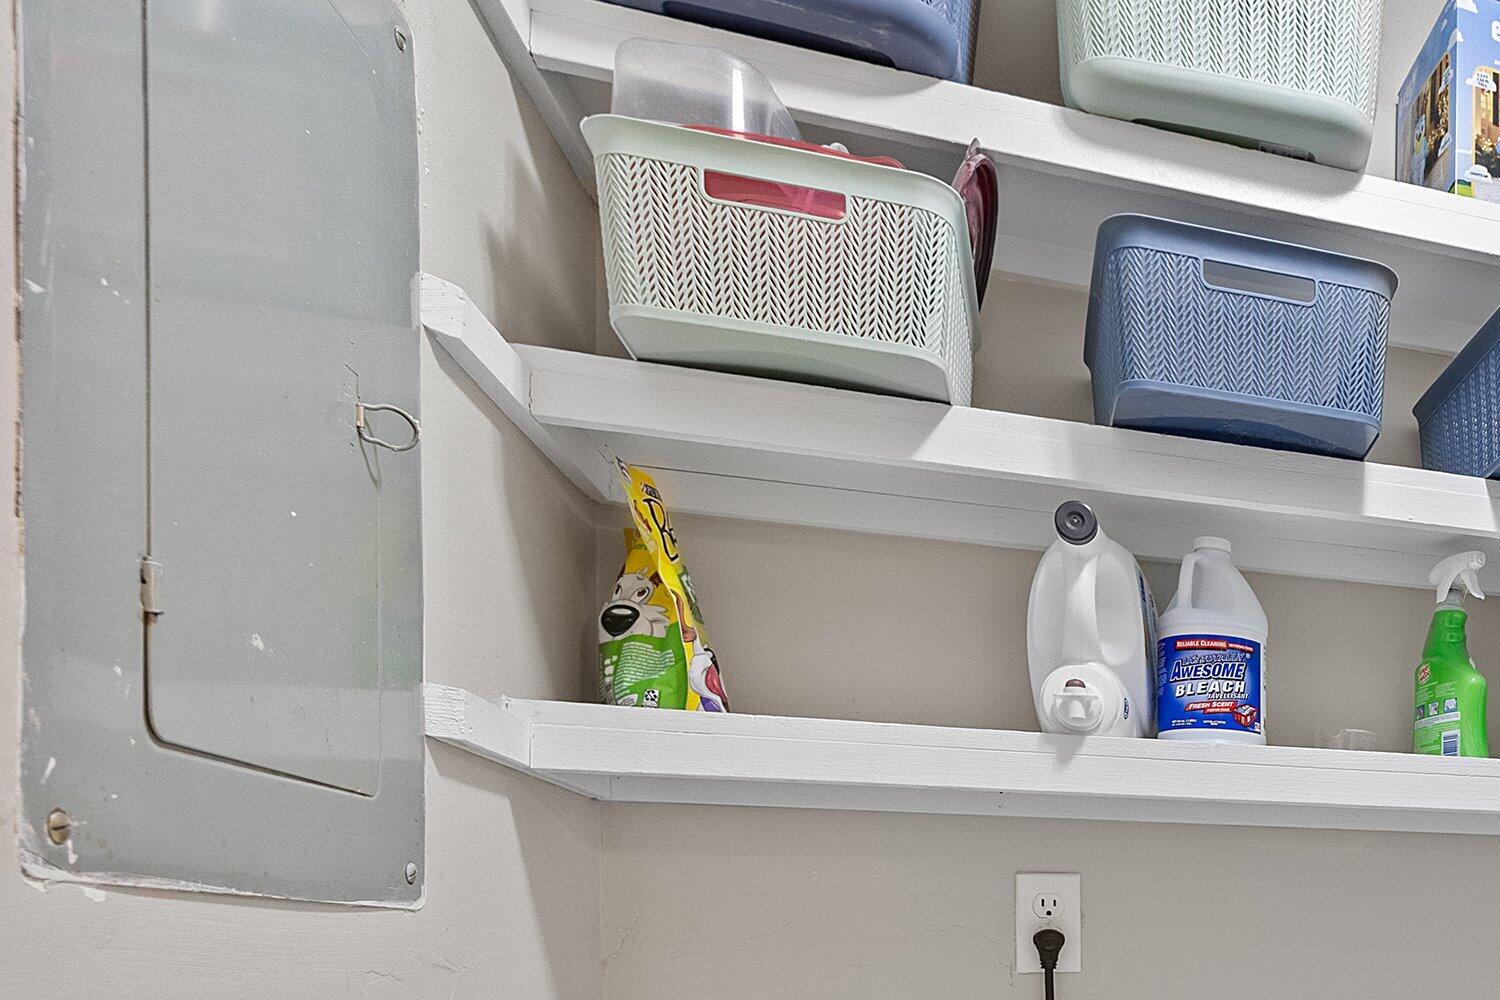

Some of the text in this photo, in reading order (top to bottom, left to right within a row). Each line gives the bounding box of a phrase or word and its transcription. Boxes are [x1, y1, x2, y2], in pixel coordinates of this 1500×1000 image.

[1170, 659, 1247, 682] AWESOME
[1175, 680, 1246, 698] BLEACH
[1188, 702, 1211, 710] FRESH
